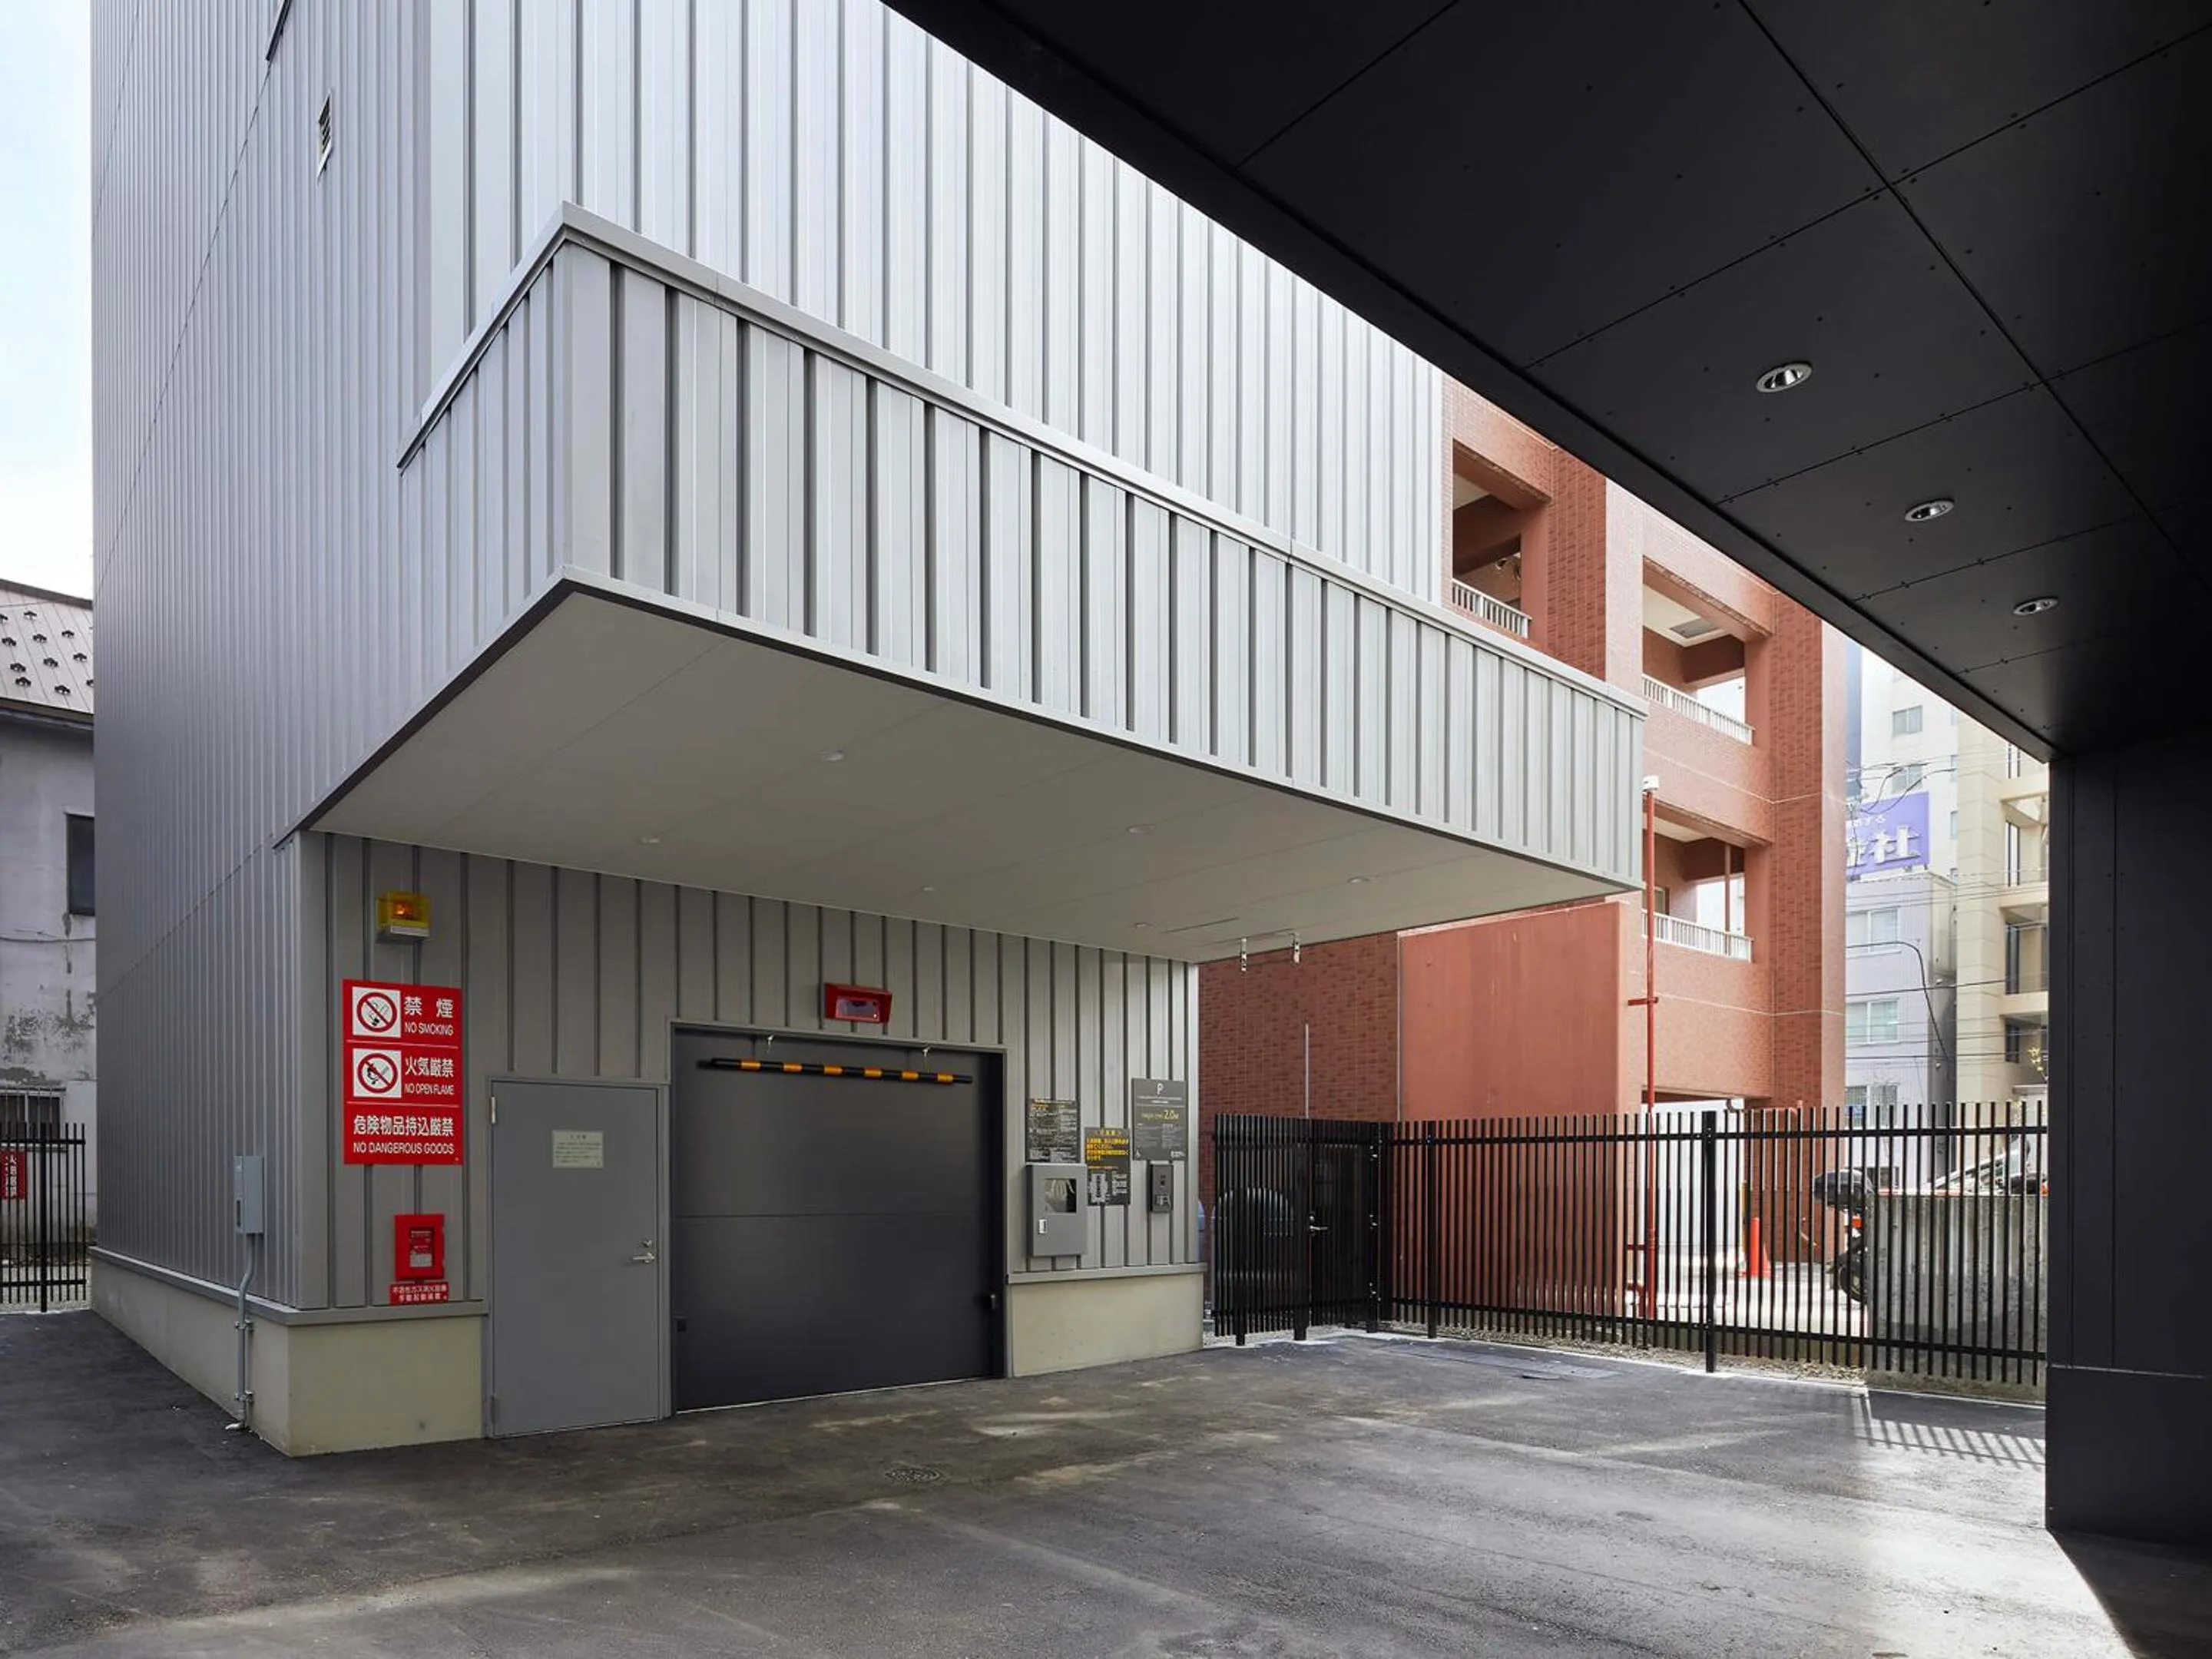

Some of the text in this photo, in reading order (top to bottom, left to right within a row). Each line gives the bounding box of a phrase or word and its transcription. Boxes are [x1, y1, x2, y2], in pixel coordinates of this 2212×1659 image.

[404, 996, 454, 1018] 禁煙
[405, 1022, 455, 1036] NO SMOKING
[404, 1055, 454, 1078] 火気厳禁
[404, 1082, 455, 1095] NO OPEN FLAME
[1157, 1083, 1164, 1095] P
[353, 1114, 454, 1136] 危険物品持込厳禁
[353, 1141, 455, 1154] NO DANGEROUS GOODS
